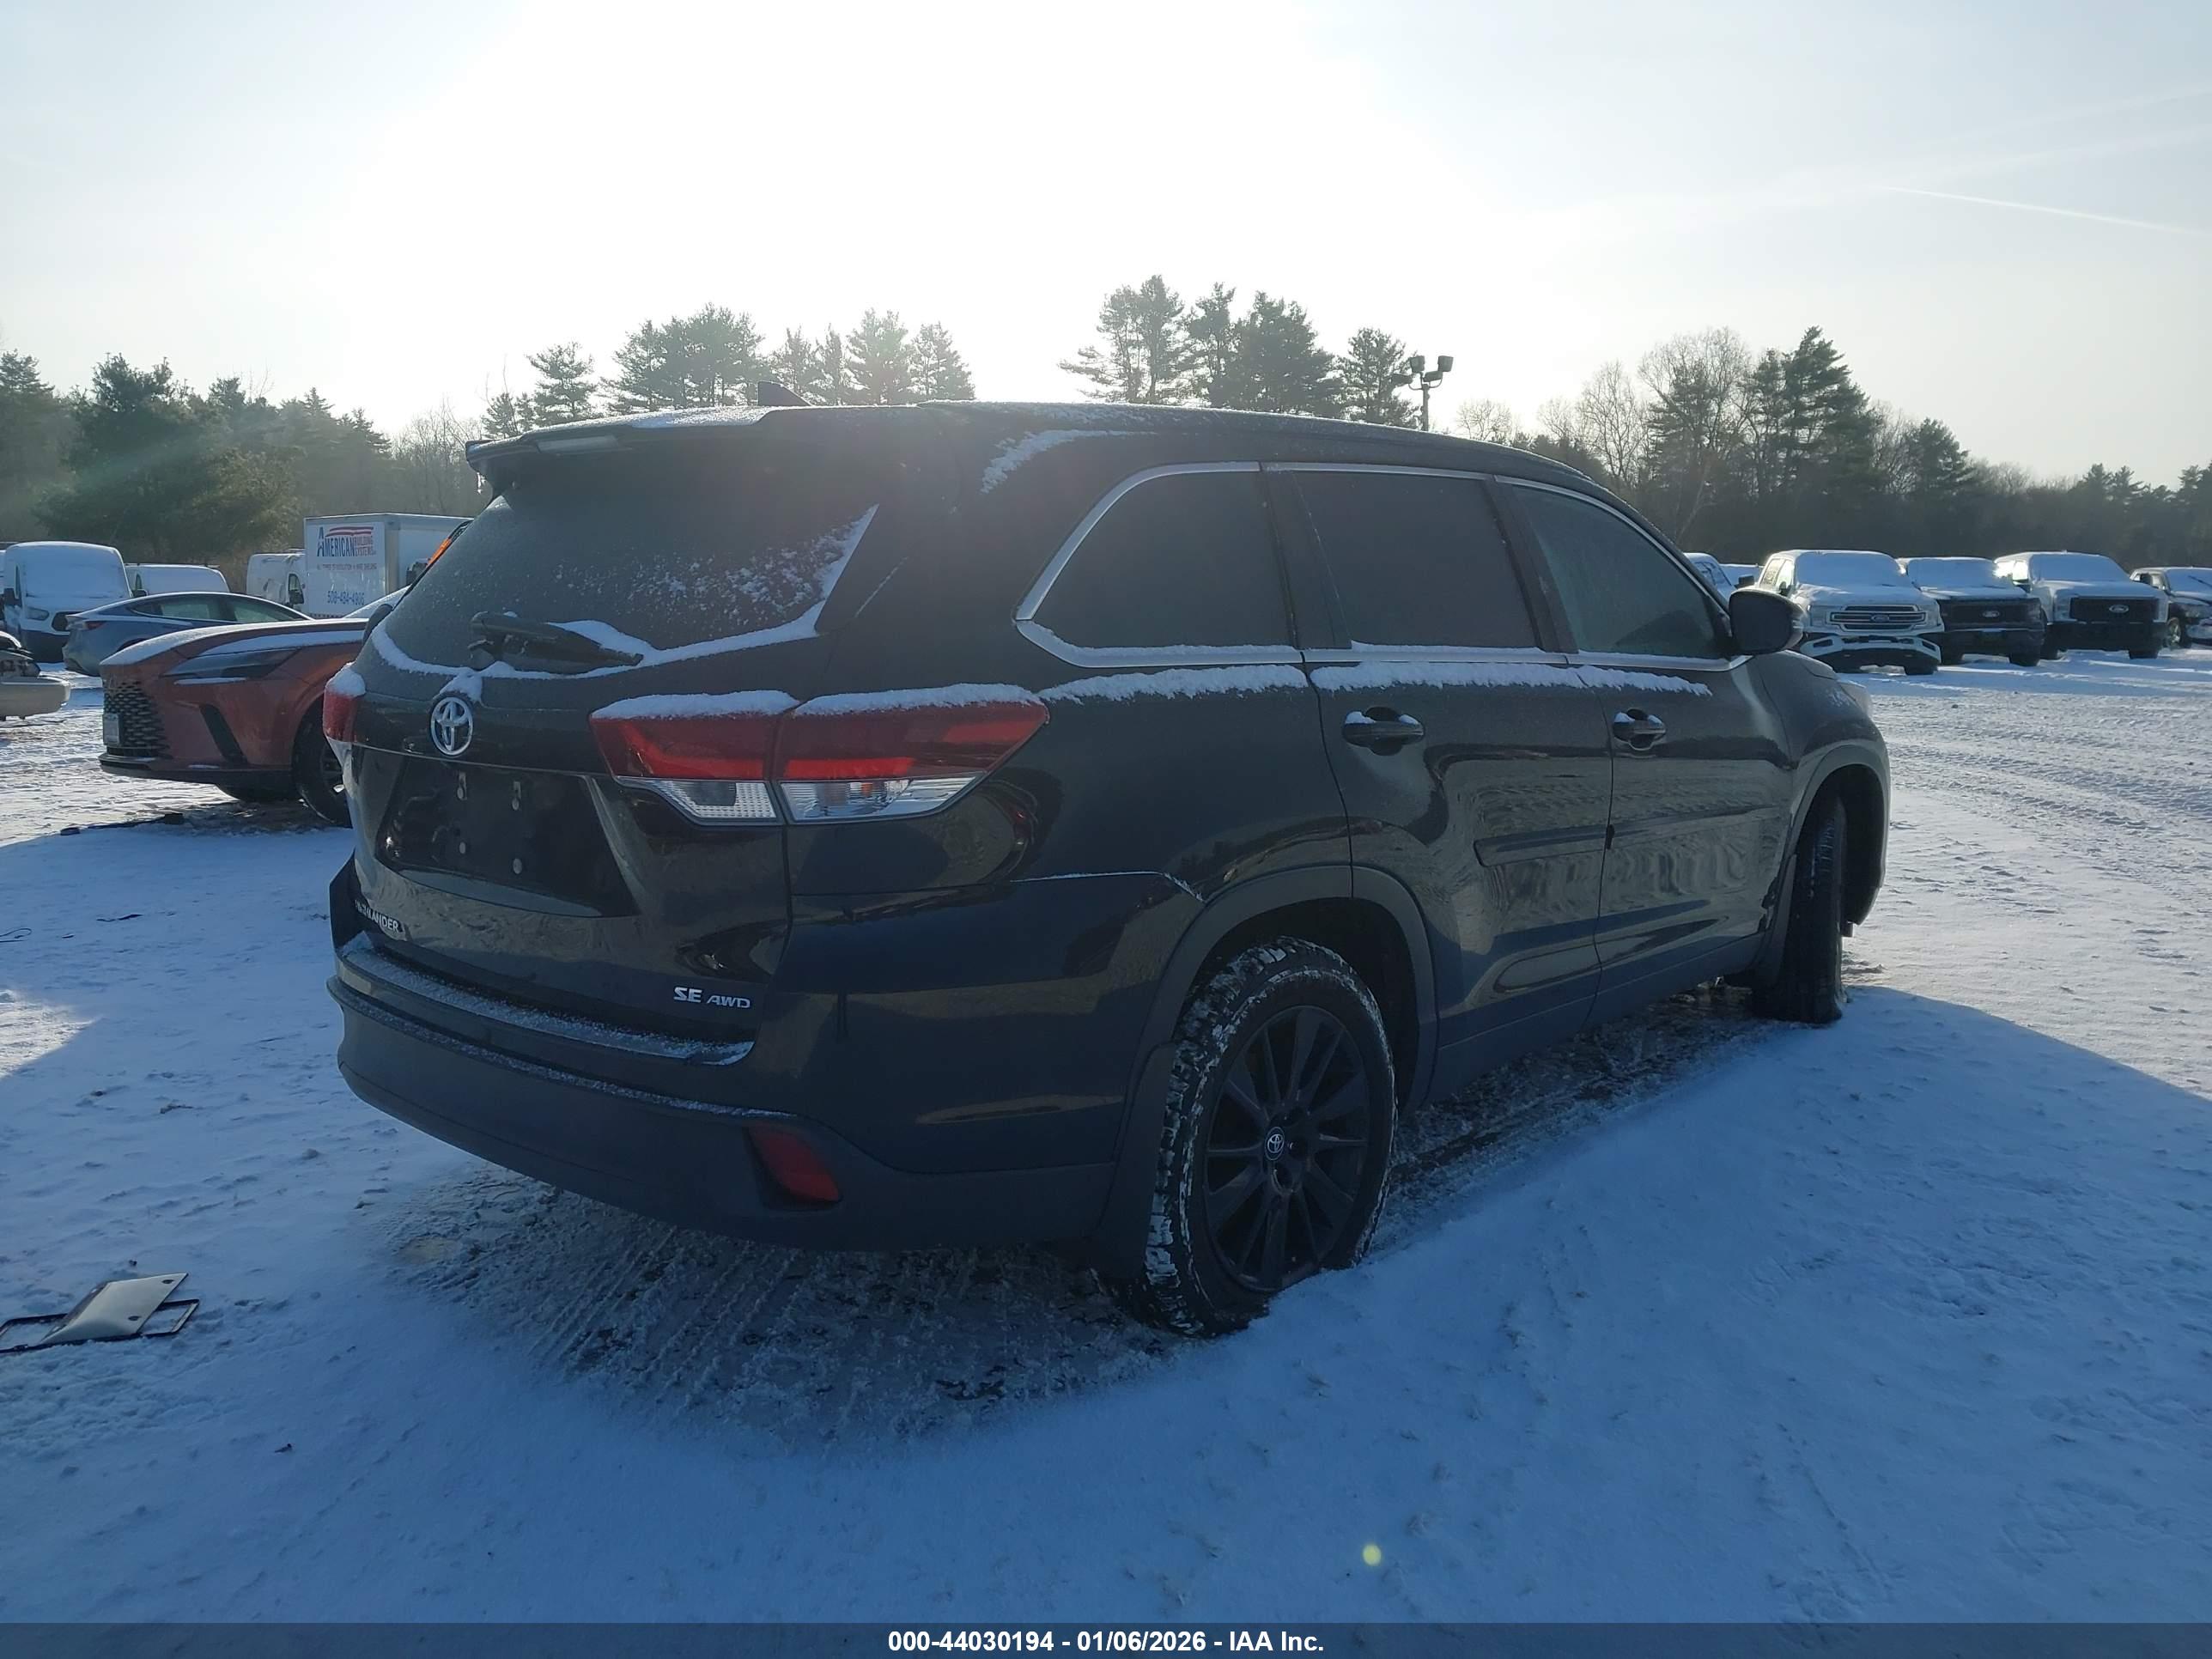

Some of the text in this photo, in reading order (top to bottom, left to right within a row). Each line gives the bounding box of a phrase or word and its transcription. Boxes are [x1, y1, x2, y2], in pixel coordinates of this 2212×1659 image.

[316, 526, 355, 557] AMERICAN
[673, 987, 750, 1009] SE AWD
